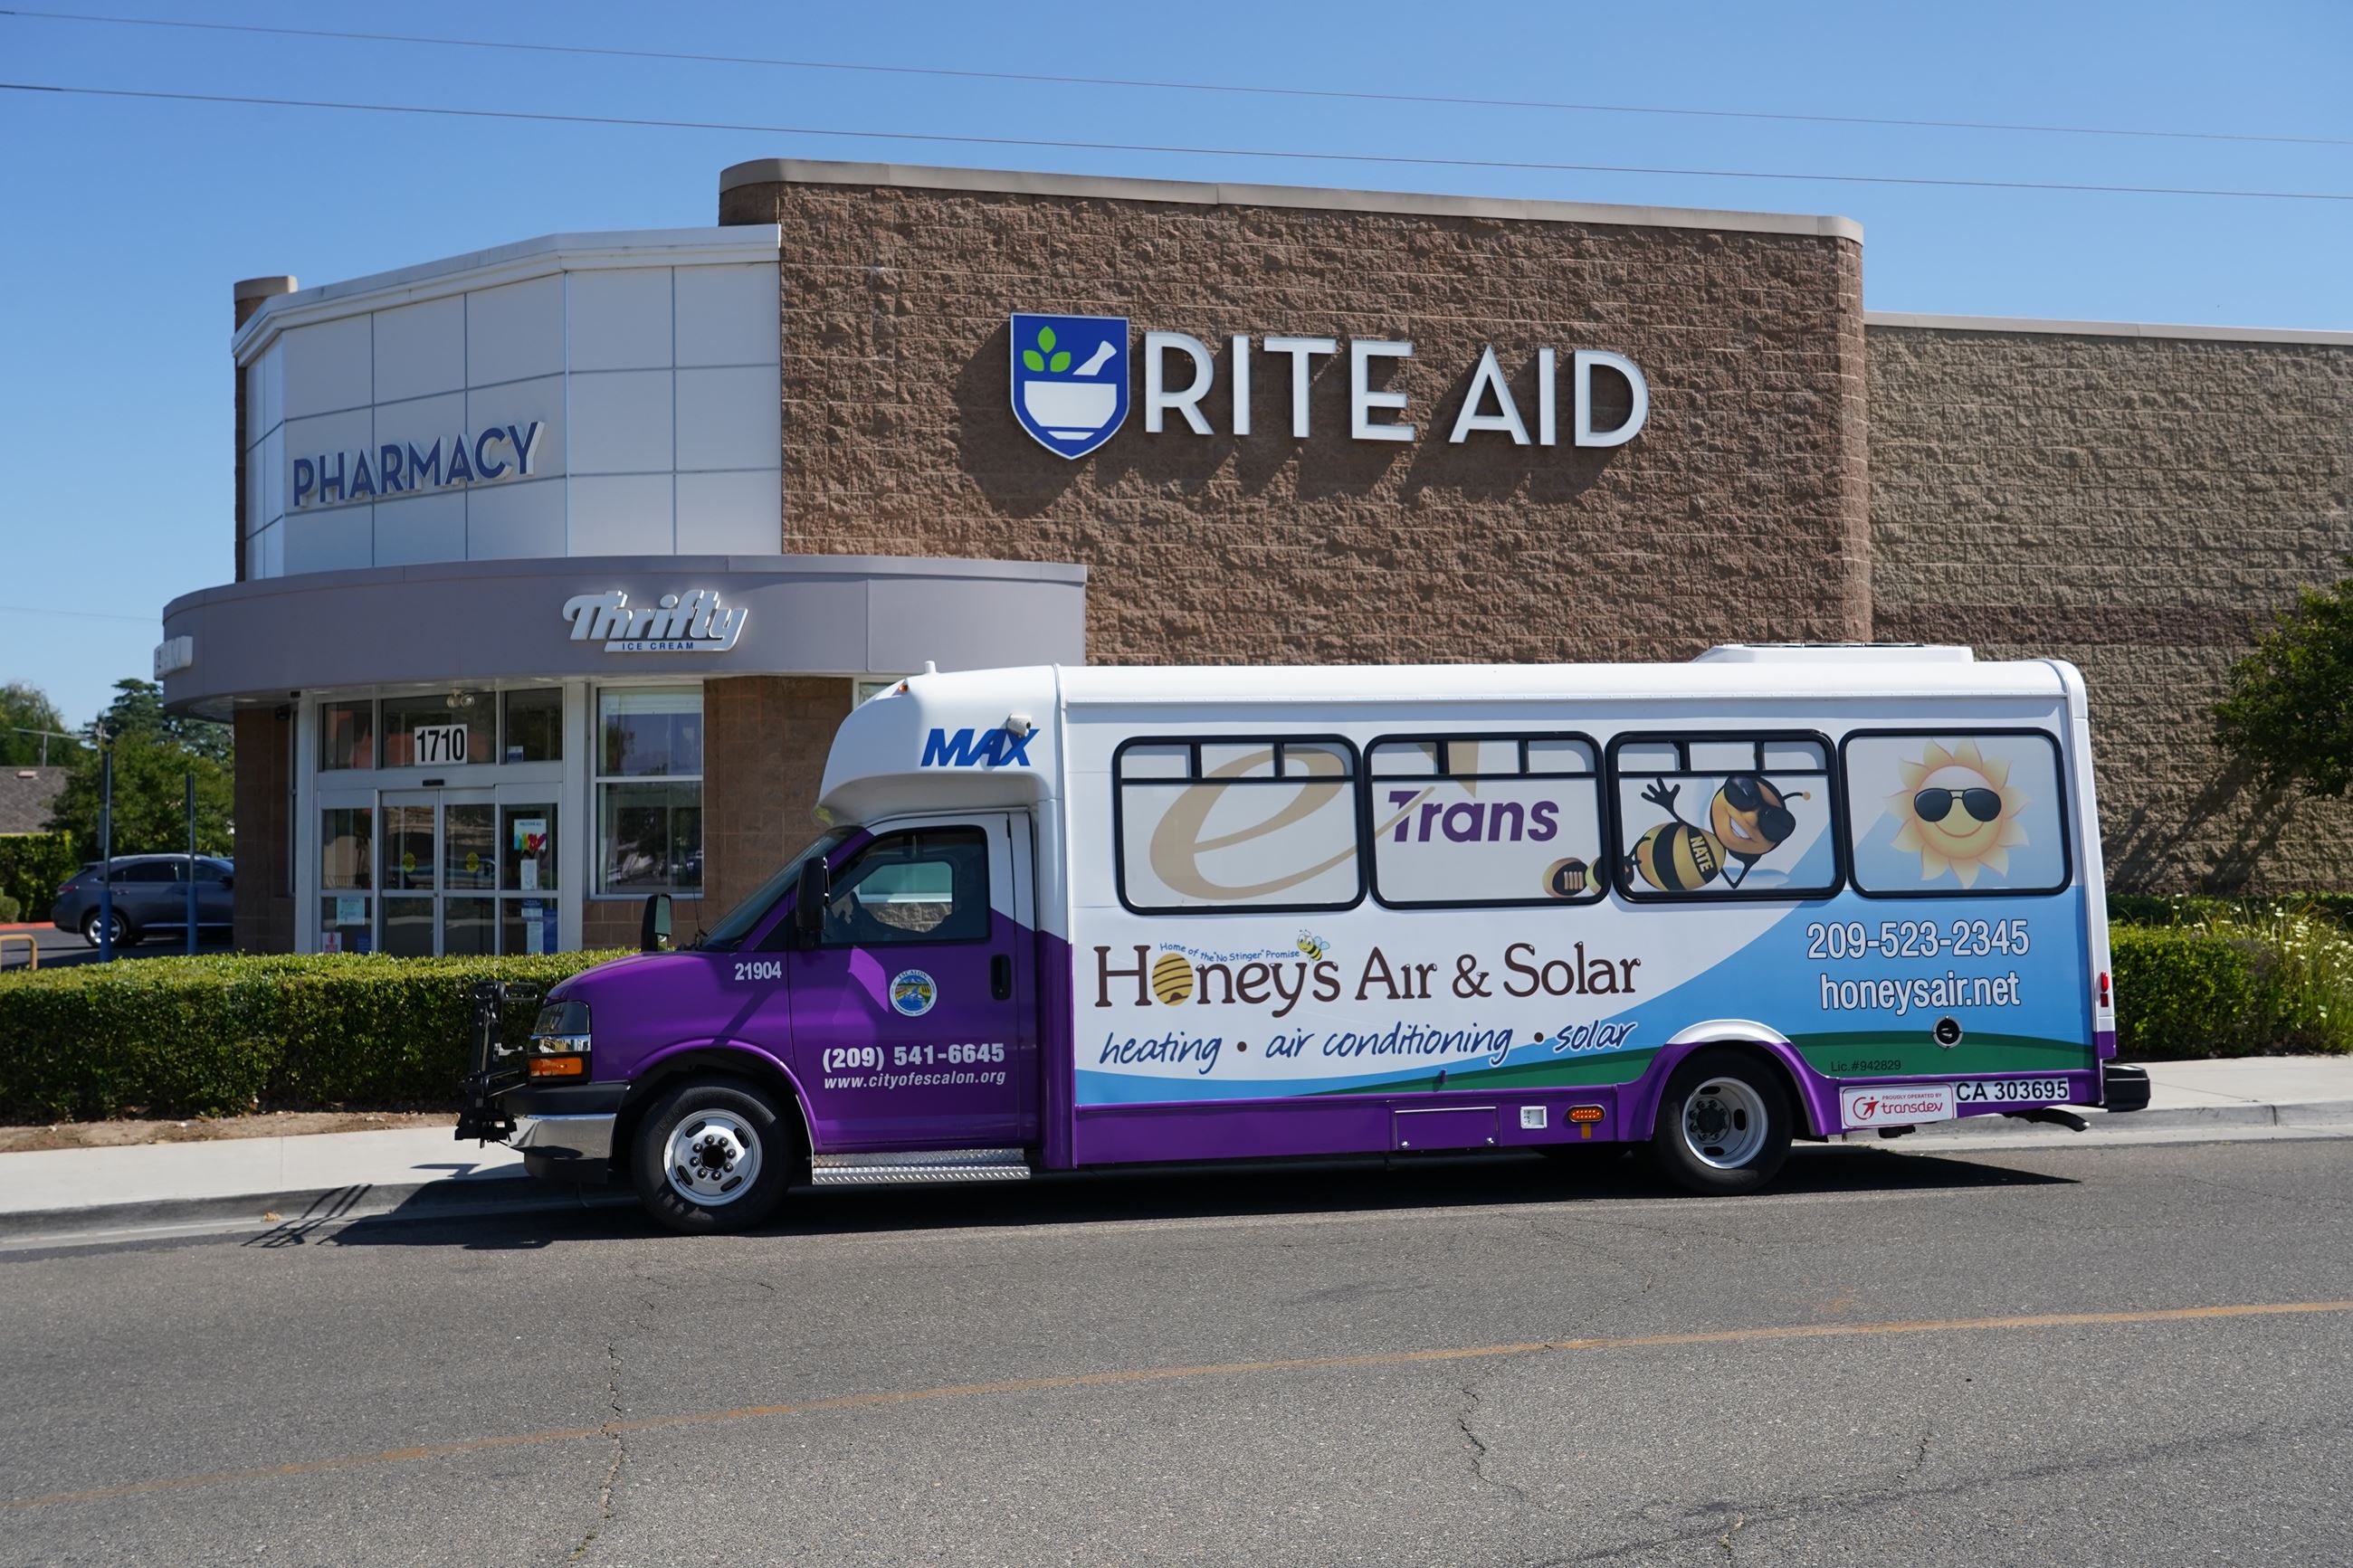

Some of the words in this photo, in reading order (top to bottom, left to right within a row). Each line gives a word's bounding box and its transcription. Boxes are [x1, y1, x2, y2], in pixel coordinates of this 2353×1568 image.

[1145, 331, 1416, 442] RITE
[1448, 345, 1650, 448] AID
[293, 421, 545, 508] PHARMACY
[563, 589, 748, 652] Thrifty
[622, 642, 643, 651] ICE
[650, 641, 694, 651] CREAM
[416, 727, 465, 762] 1710
[920, 728, 1040, 766] MAX
[1690, 835, 1714, 872] NATE
[1159, 943, 1186, 952] Home
[1188, 948, 1199, 956] of
[1200, 952, 1214, 961] the
[1229, 949, 1264, 962] Stinger"
[1266, 950, 1300, 959] Promise
[1806, 919, 2030, 959] 209-523-2345
[735, 961, 782, 981] 21904
[1355, 946, 1437, 1000] Air
[1452, 954, 1492, 999] &
[1503, 941, 1642, 997] Solar
[1820, 970, 2021, 1016] honeysair.net
[822, 1047, 885, 1073] (209)
[893, 1043, 1005, 1066] 541-6645
[1099, 1031, 1223, 1075] heating
[1265, 1028, 1315, 1058] air
[1322, 1021, 1514, 1066] conditioning
[1553, 1020, 1637, 1052] solar
[824, 1070, 1006, 1089] www.cityofescalon.org
[1831, 1060, 1901, 1072] Lic.#942829
[1881, 1100, 1943, 1115] transdev
[1956, 1082, 1988, 1101] CA
[1995, 1080, 2069, 1100] 303695
